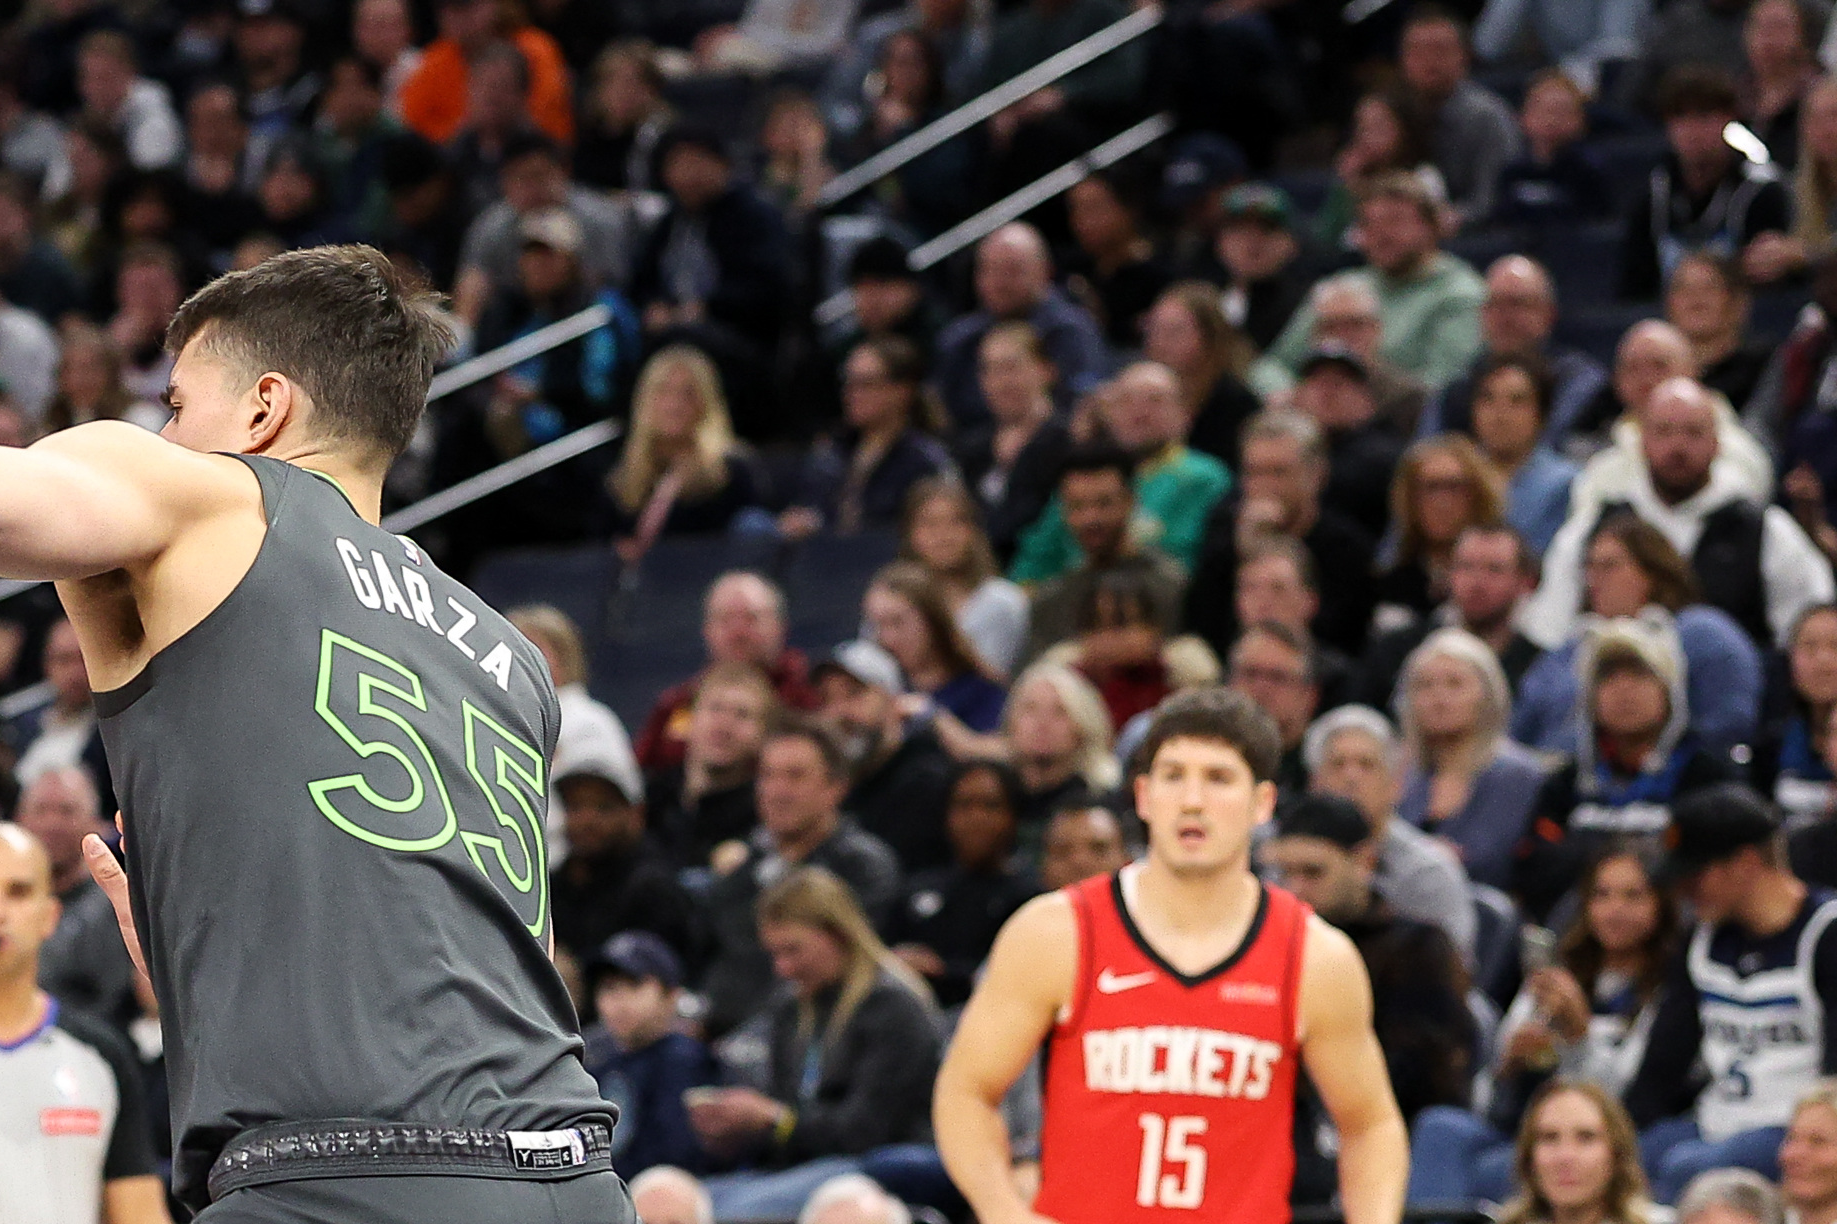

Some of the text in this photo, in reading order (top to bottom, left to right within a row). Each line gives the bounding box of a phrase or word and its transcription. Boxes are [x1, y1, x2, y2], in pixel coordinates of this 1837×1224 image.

[336, 537, 513, 692] GARZA
[307, 628, 545, 938] 55
[1082, 1025, 1283, 1100] ROCKETS
[1135, 1111, 1210, 1210] 15
